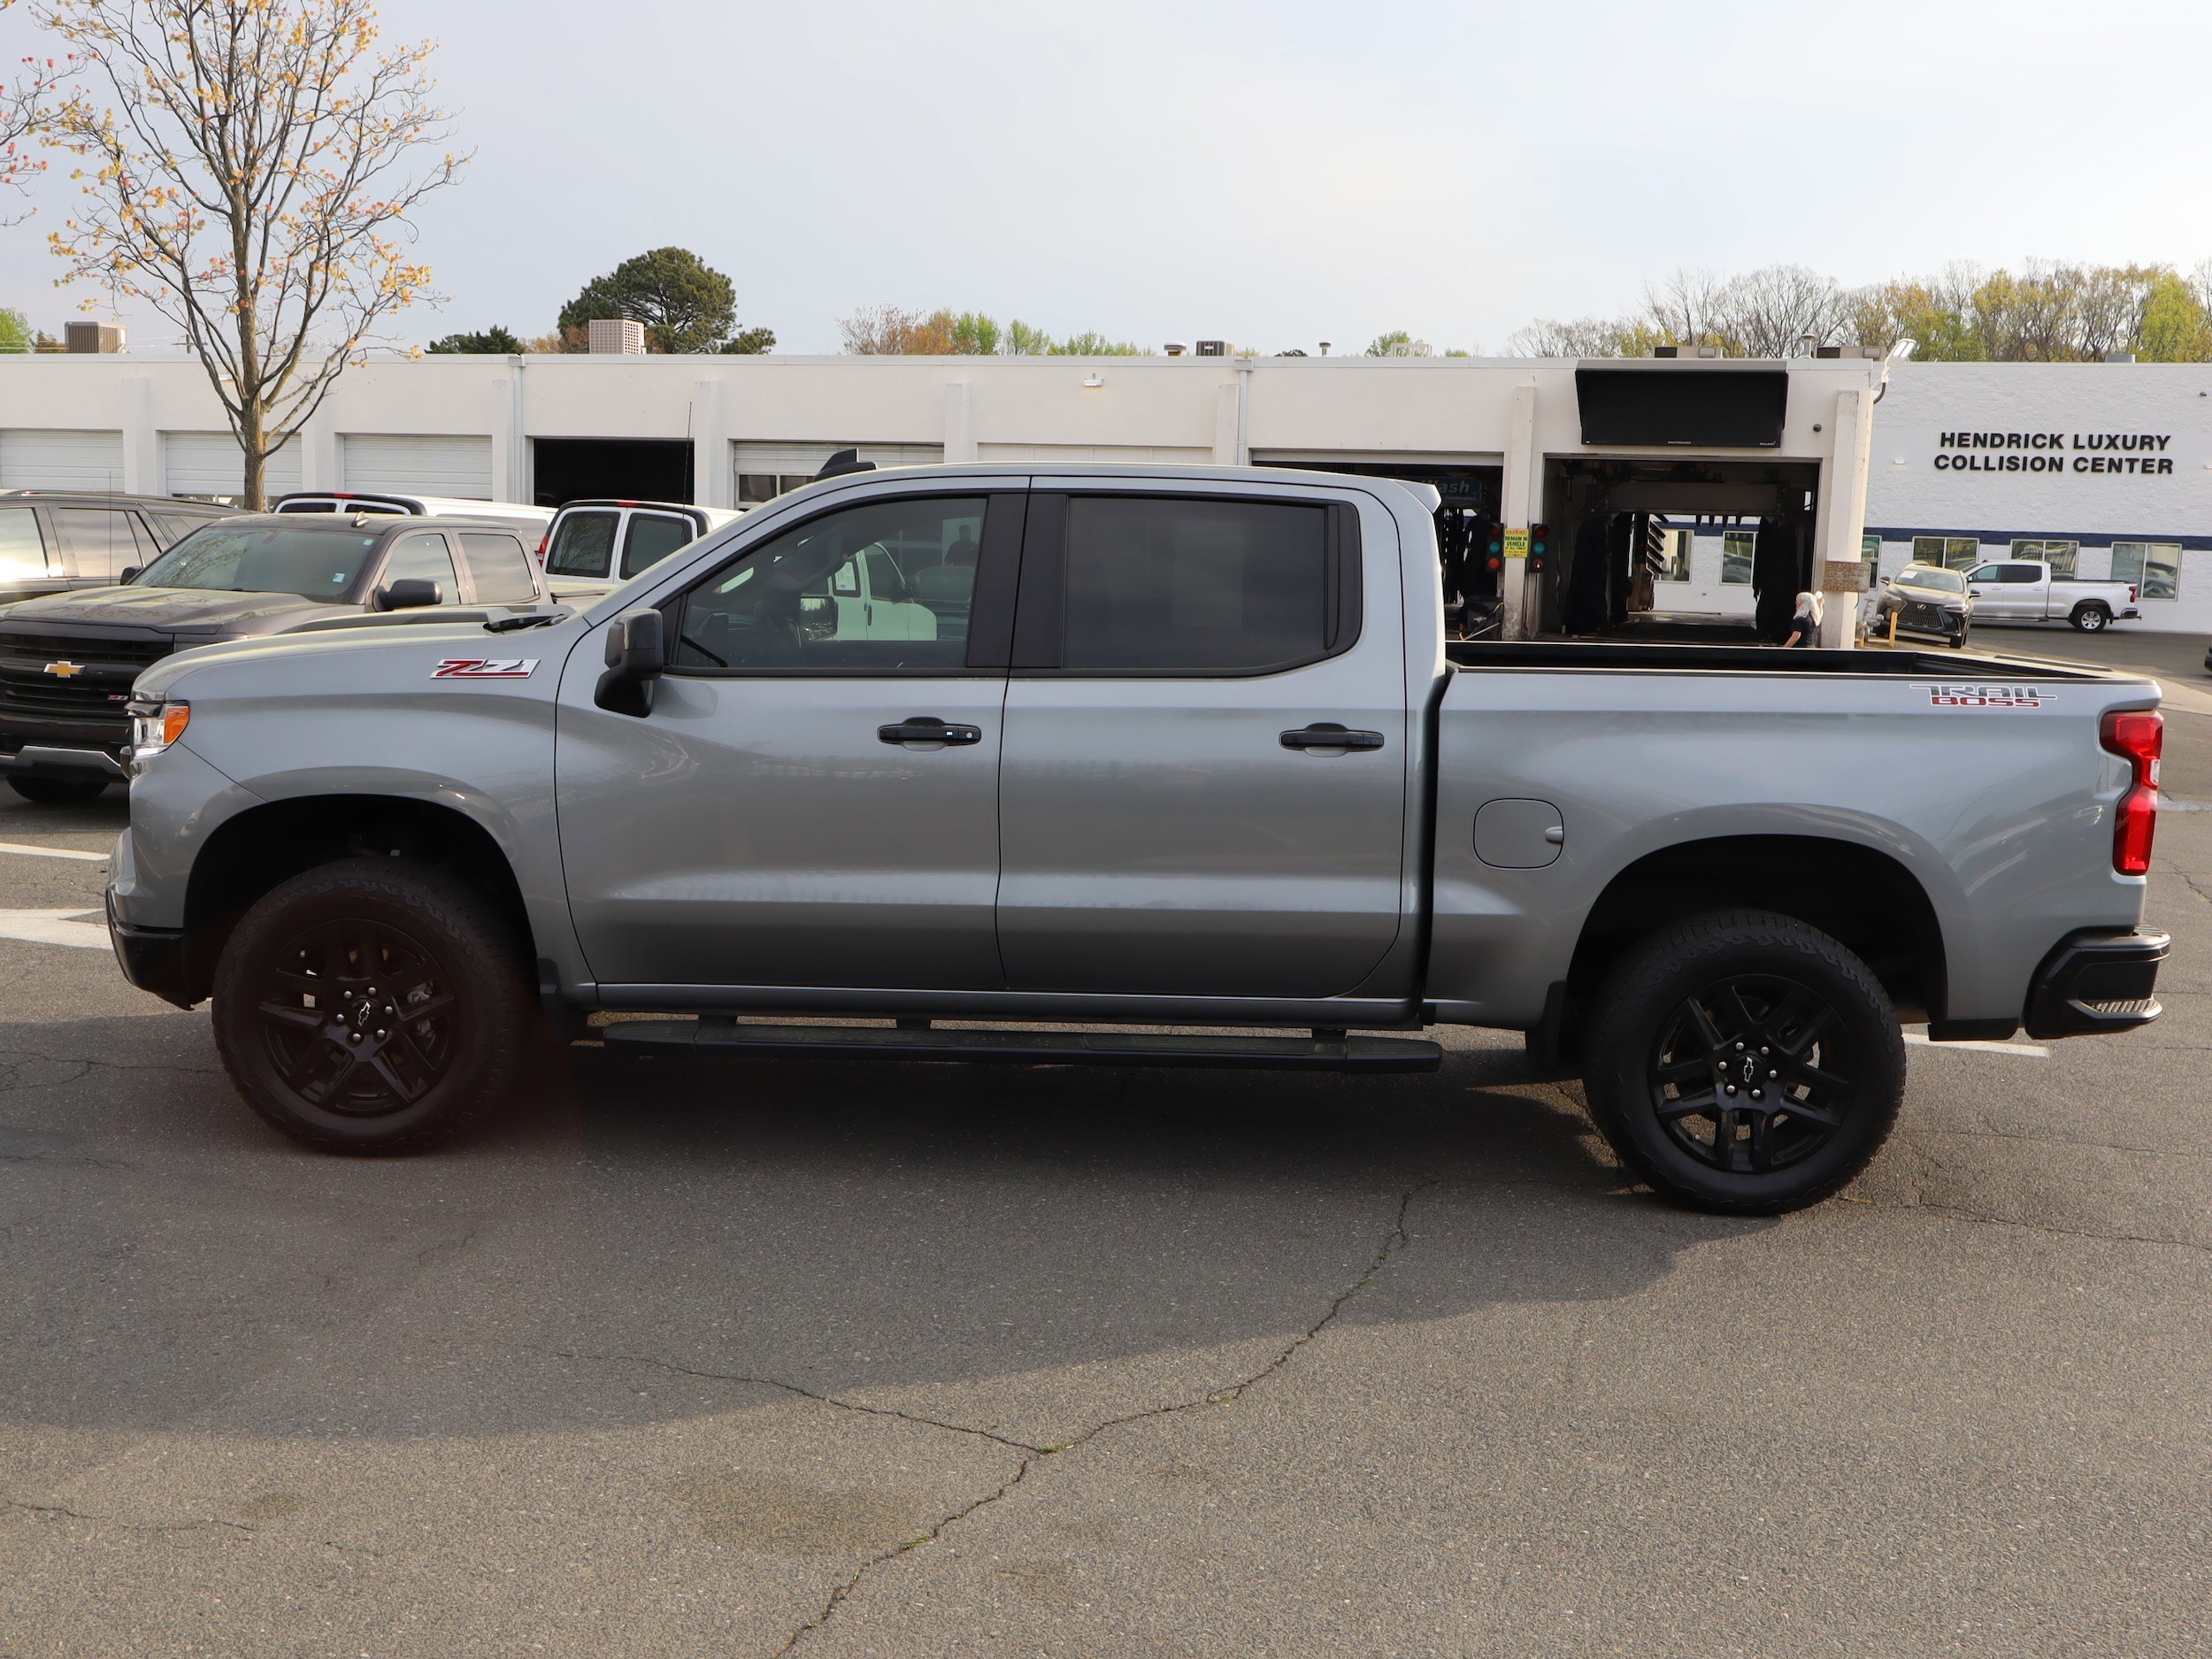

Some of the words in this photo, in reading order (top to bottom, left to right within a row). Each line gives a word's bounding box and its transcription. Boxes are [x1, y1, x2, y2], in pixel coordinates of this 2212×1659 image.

[1939, 432, 2065, 450] HENDRICK
[2073, 434, 2172, 451] LUXURY
[1933, 454, 2064, 472] COLLISION
[2072, 457, 2174, 474] CENTER
[430, 658, 541, 679] Z71
[1909, 684, 2058, 700] TRAIL
[1931, 695, 2041, 709] BOSS
